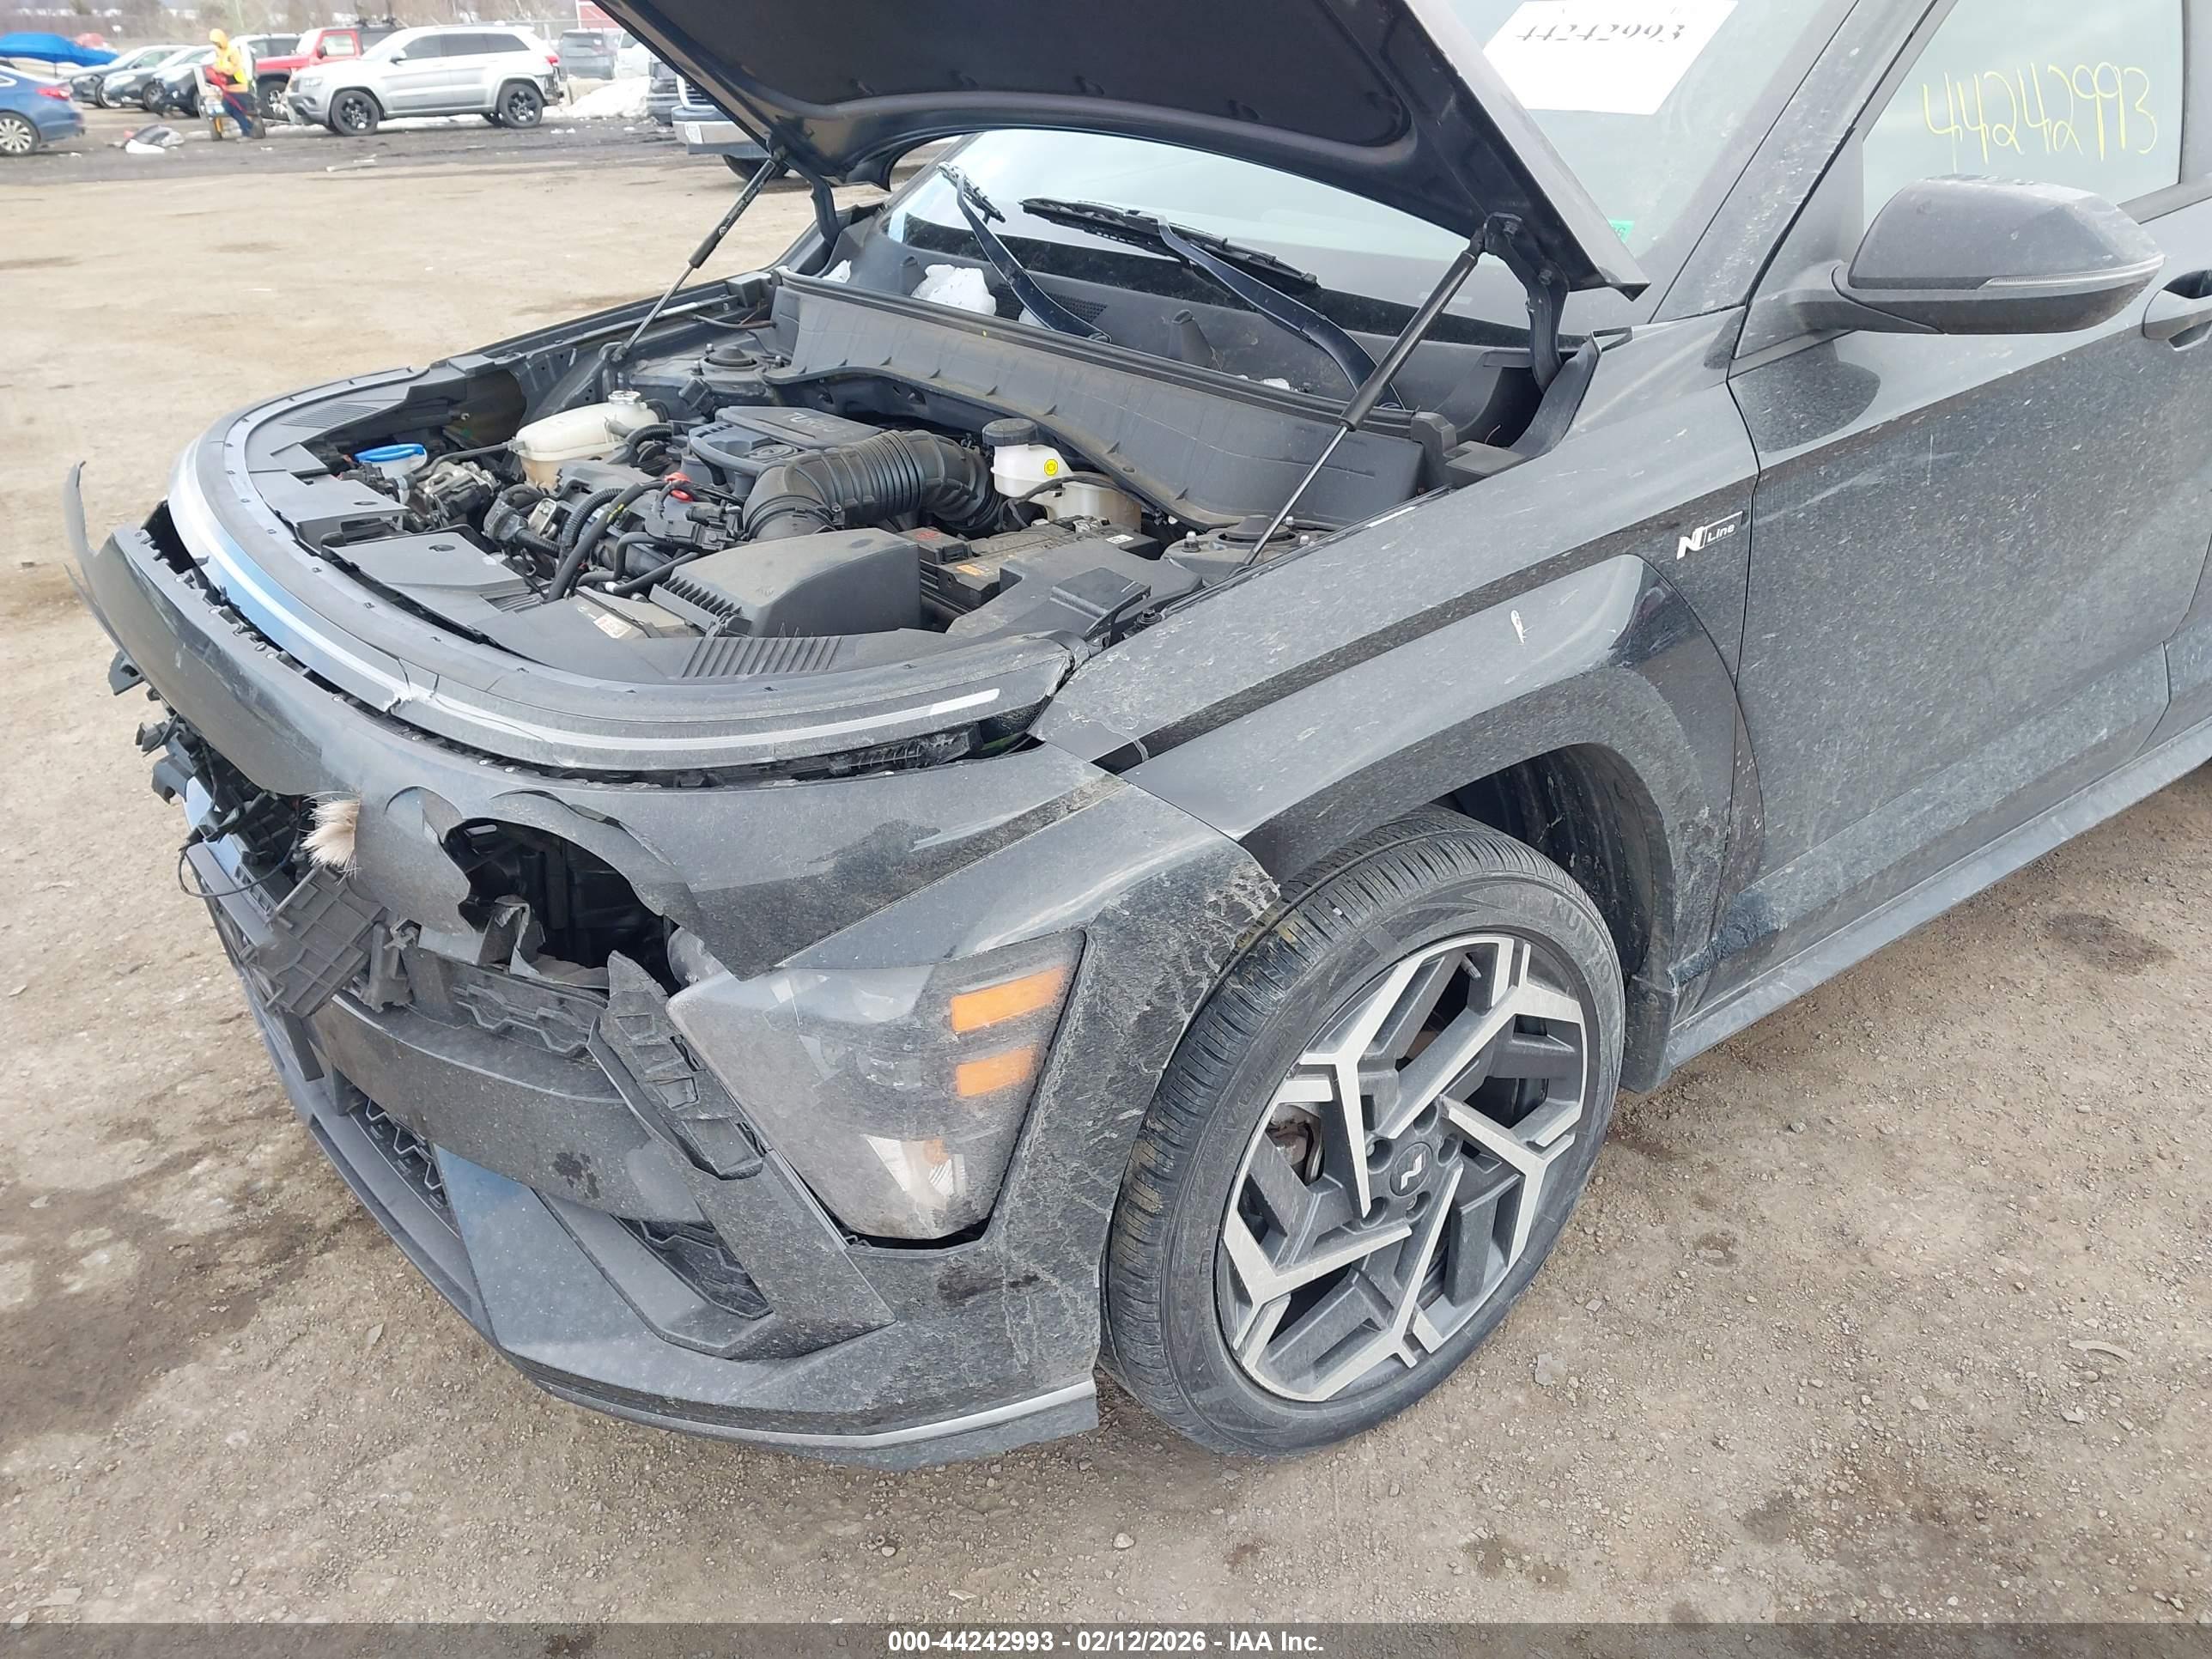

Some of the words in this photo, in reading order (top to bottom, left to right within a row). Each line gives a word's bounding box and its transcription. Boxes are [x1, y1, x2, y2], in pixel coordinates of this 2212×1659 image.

[1921, 61, 2159, 173] 44242993
[1676, 526, 1707, 561] N
[1707, 524, 1735, 543] Line
